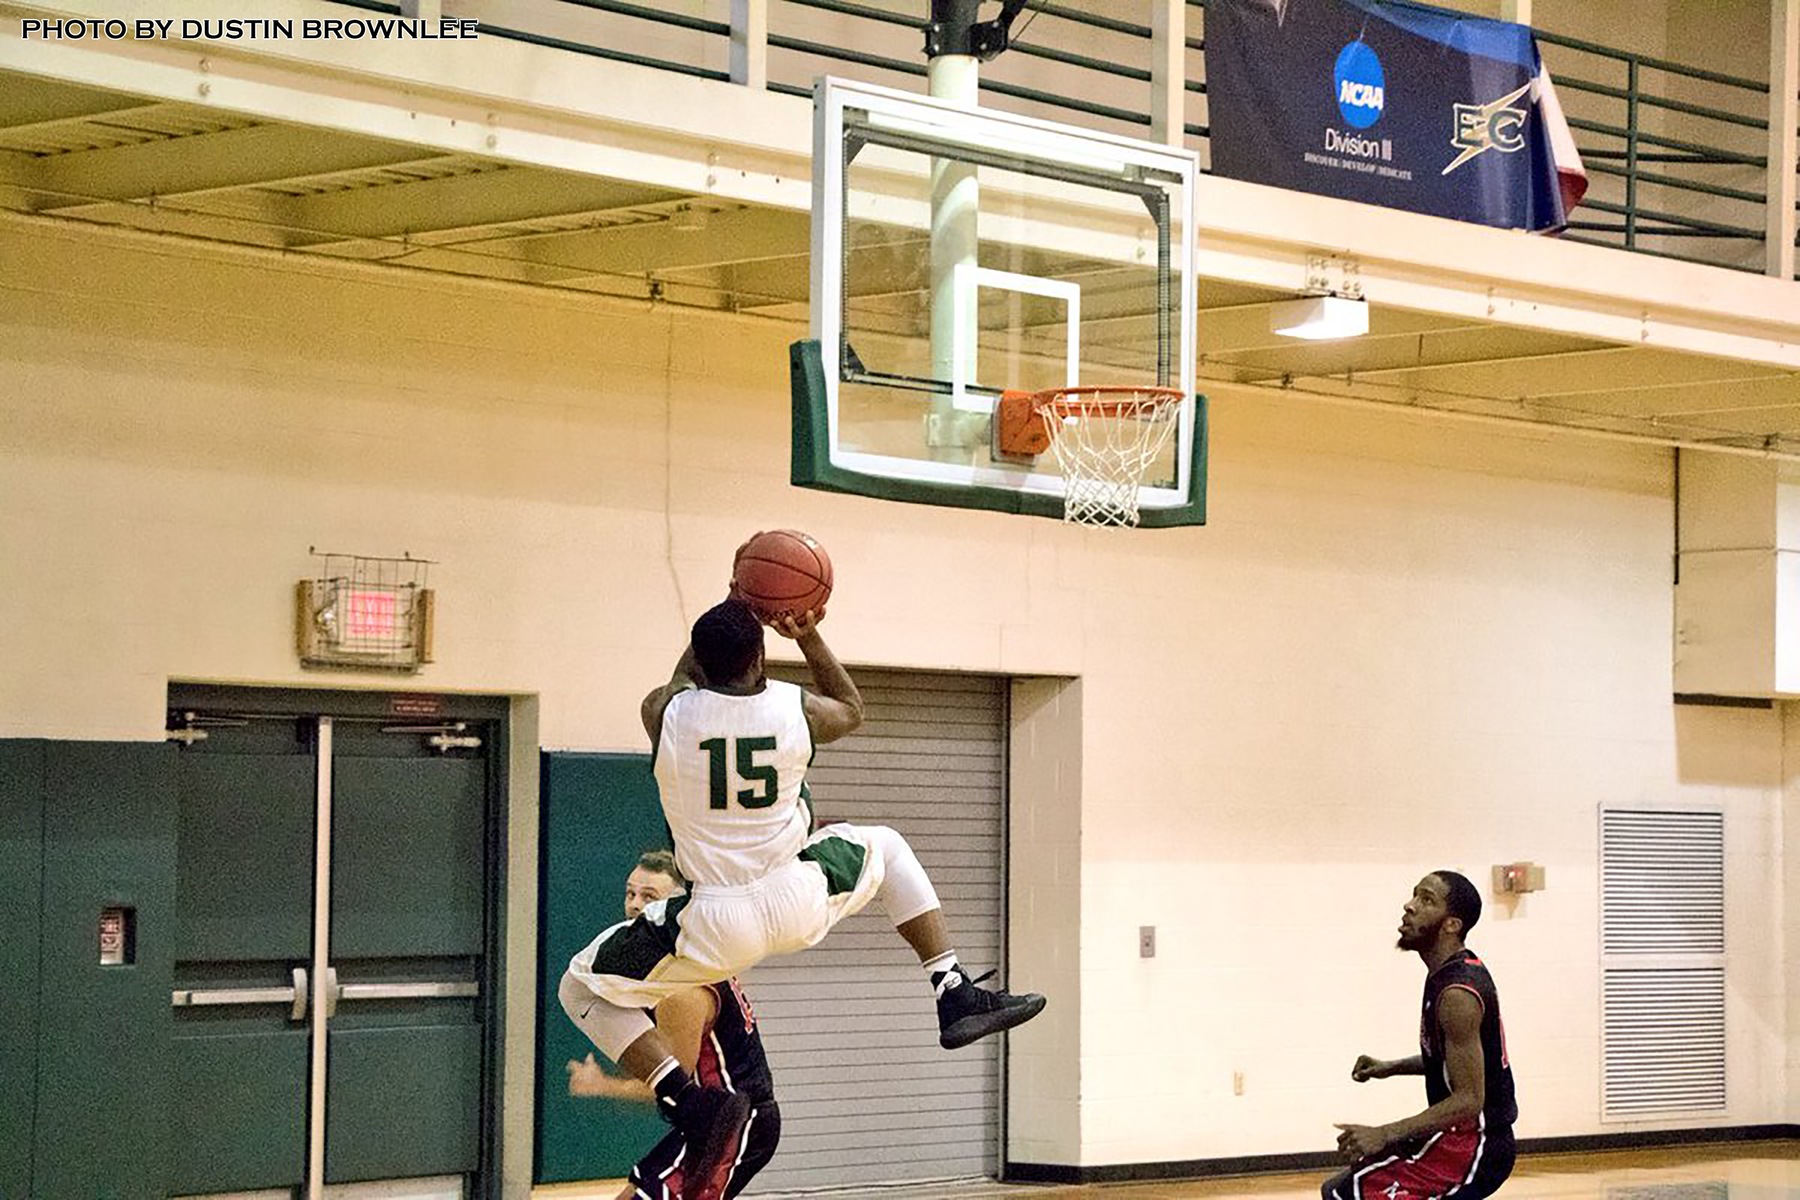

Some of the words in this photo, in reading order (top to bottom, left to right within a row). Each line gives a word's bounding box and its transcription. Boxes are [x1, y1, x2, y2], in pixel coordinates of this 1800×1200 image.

[1339, 79, 1384, 111] NCAA
[1325, 127, 1380, 158] Division
[698, 736, 779, 810] 15
